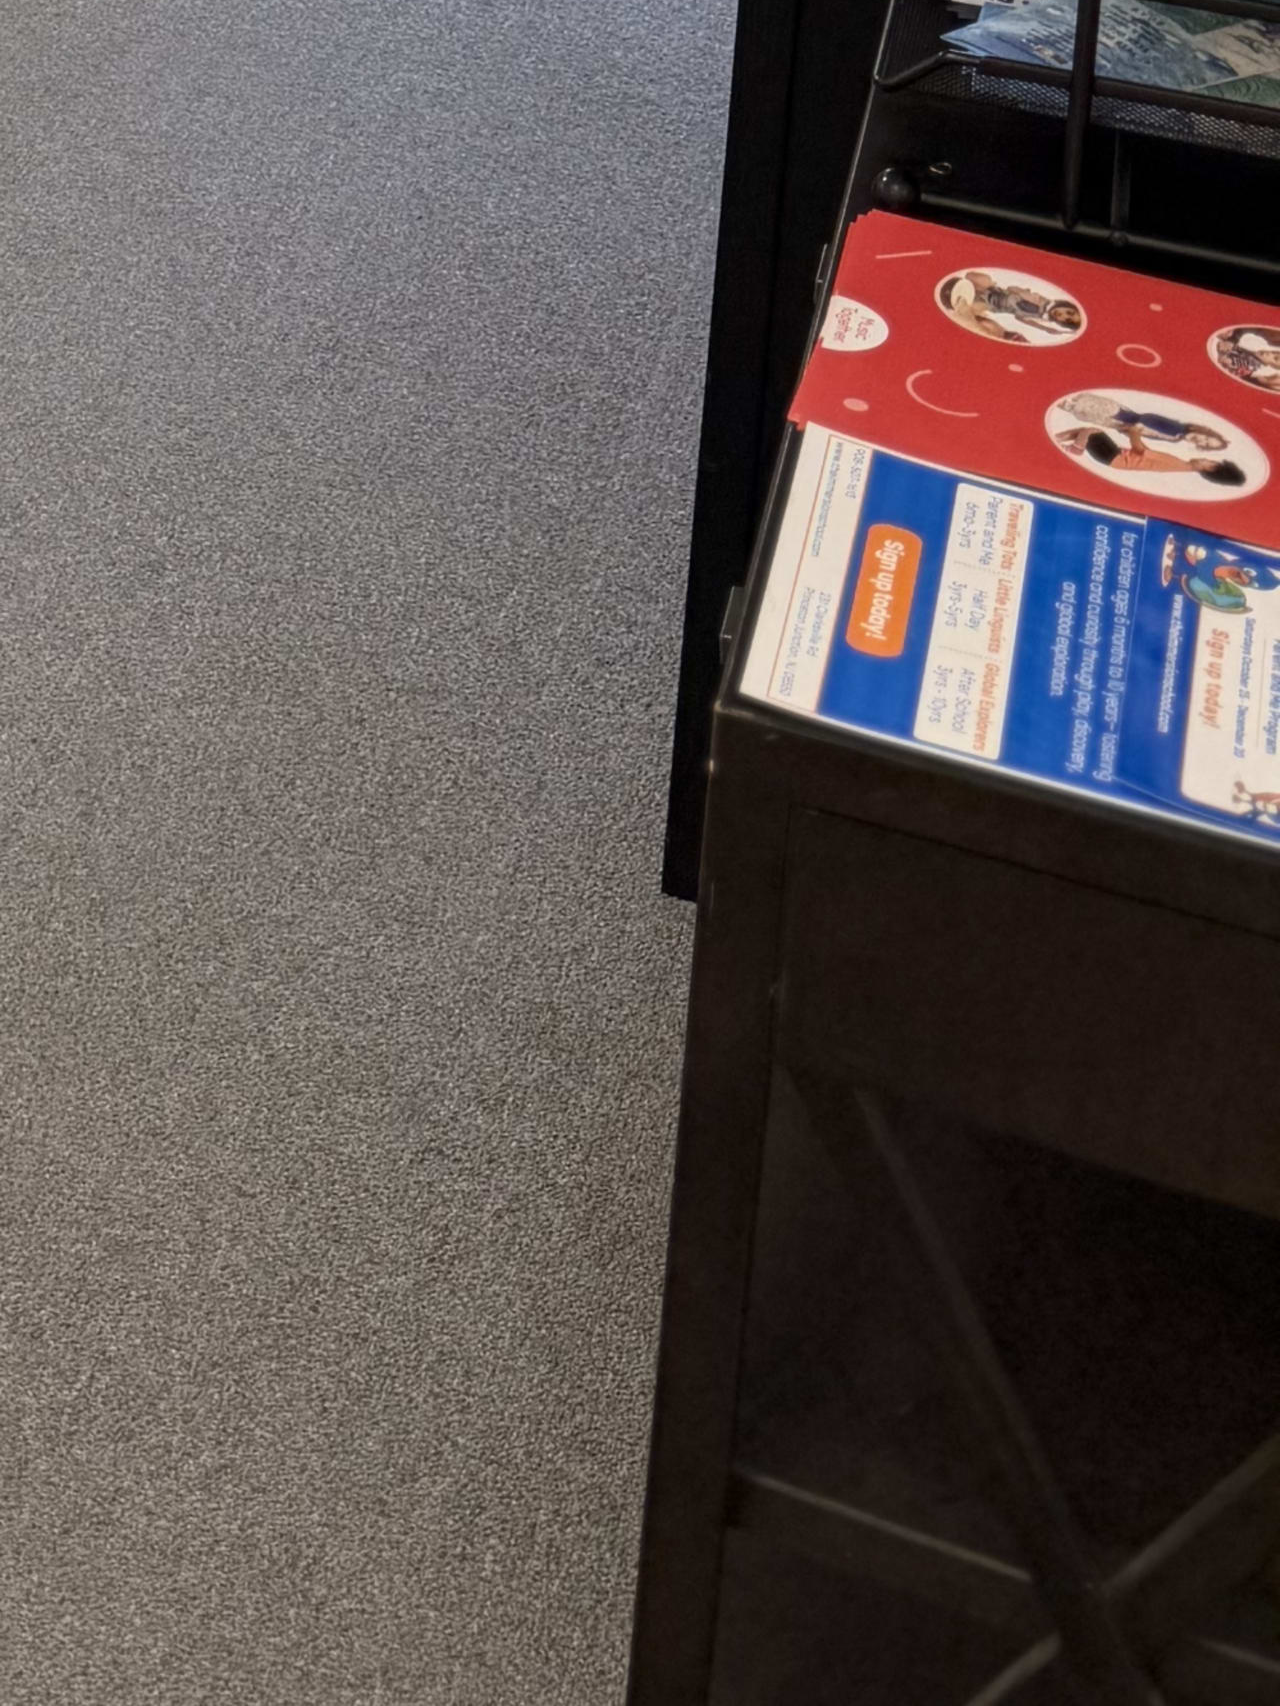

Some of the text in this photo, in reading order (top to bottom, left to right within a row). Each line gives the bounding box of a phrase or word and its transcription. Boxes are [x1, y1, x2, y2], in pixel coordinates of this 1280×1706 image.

[855, 317, 875, 340] Music
[957, 501, 979, 548] 6mo-3yrs
[979, 495, 1003, 566] Parent and Me
[1000, 501, 1025, 571] Traveling Tots
[1121, 531, 1139, 548] for
[860, 539, 905, 641] Sign up today!
[1117, 547, 1137, 588] children
[944, 580, 968, 627] 3yrs-5yrs
[967, 589, 988, 632] Half Day
[987, 578, 1013, 654] Little Linguists
[1111, 590, 1130, 615] ages
[1049, 581, 1079, 696] and global exploration.
[1064, 524, 1111, 773] confidence and curiosity through play, discovery,
[1109, 625, 1128, 664] months
[1240, 617, 1257, 655] Saturdays
[935, 665, 953, 687] 3yrs
[1107, 679, 1125, 690] 10
[1108, 666, 1125, 678] to
[1197, 627, 1232, 731] Sign up today!
[1238, 656, 1253, 688] October
[928, 696, 950, 723] 10yrs
[951, 667, 976, 735] After School
[972, 662, 1000, 752] Global Explorers
[1092, 731, 1121, 782] fostering
